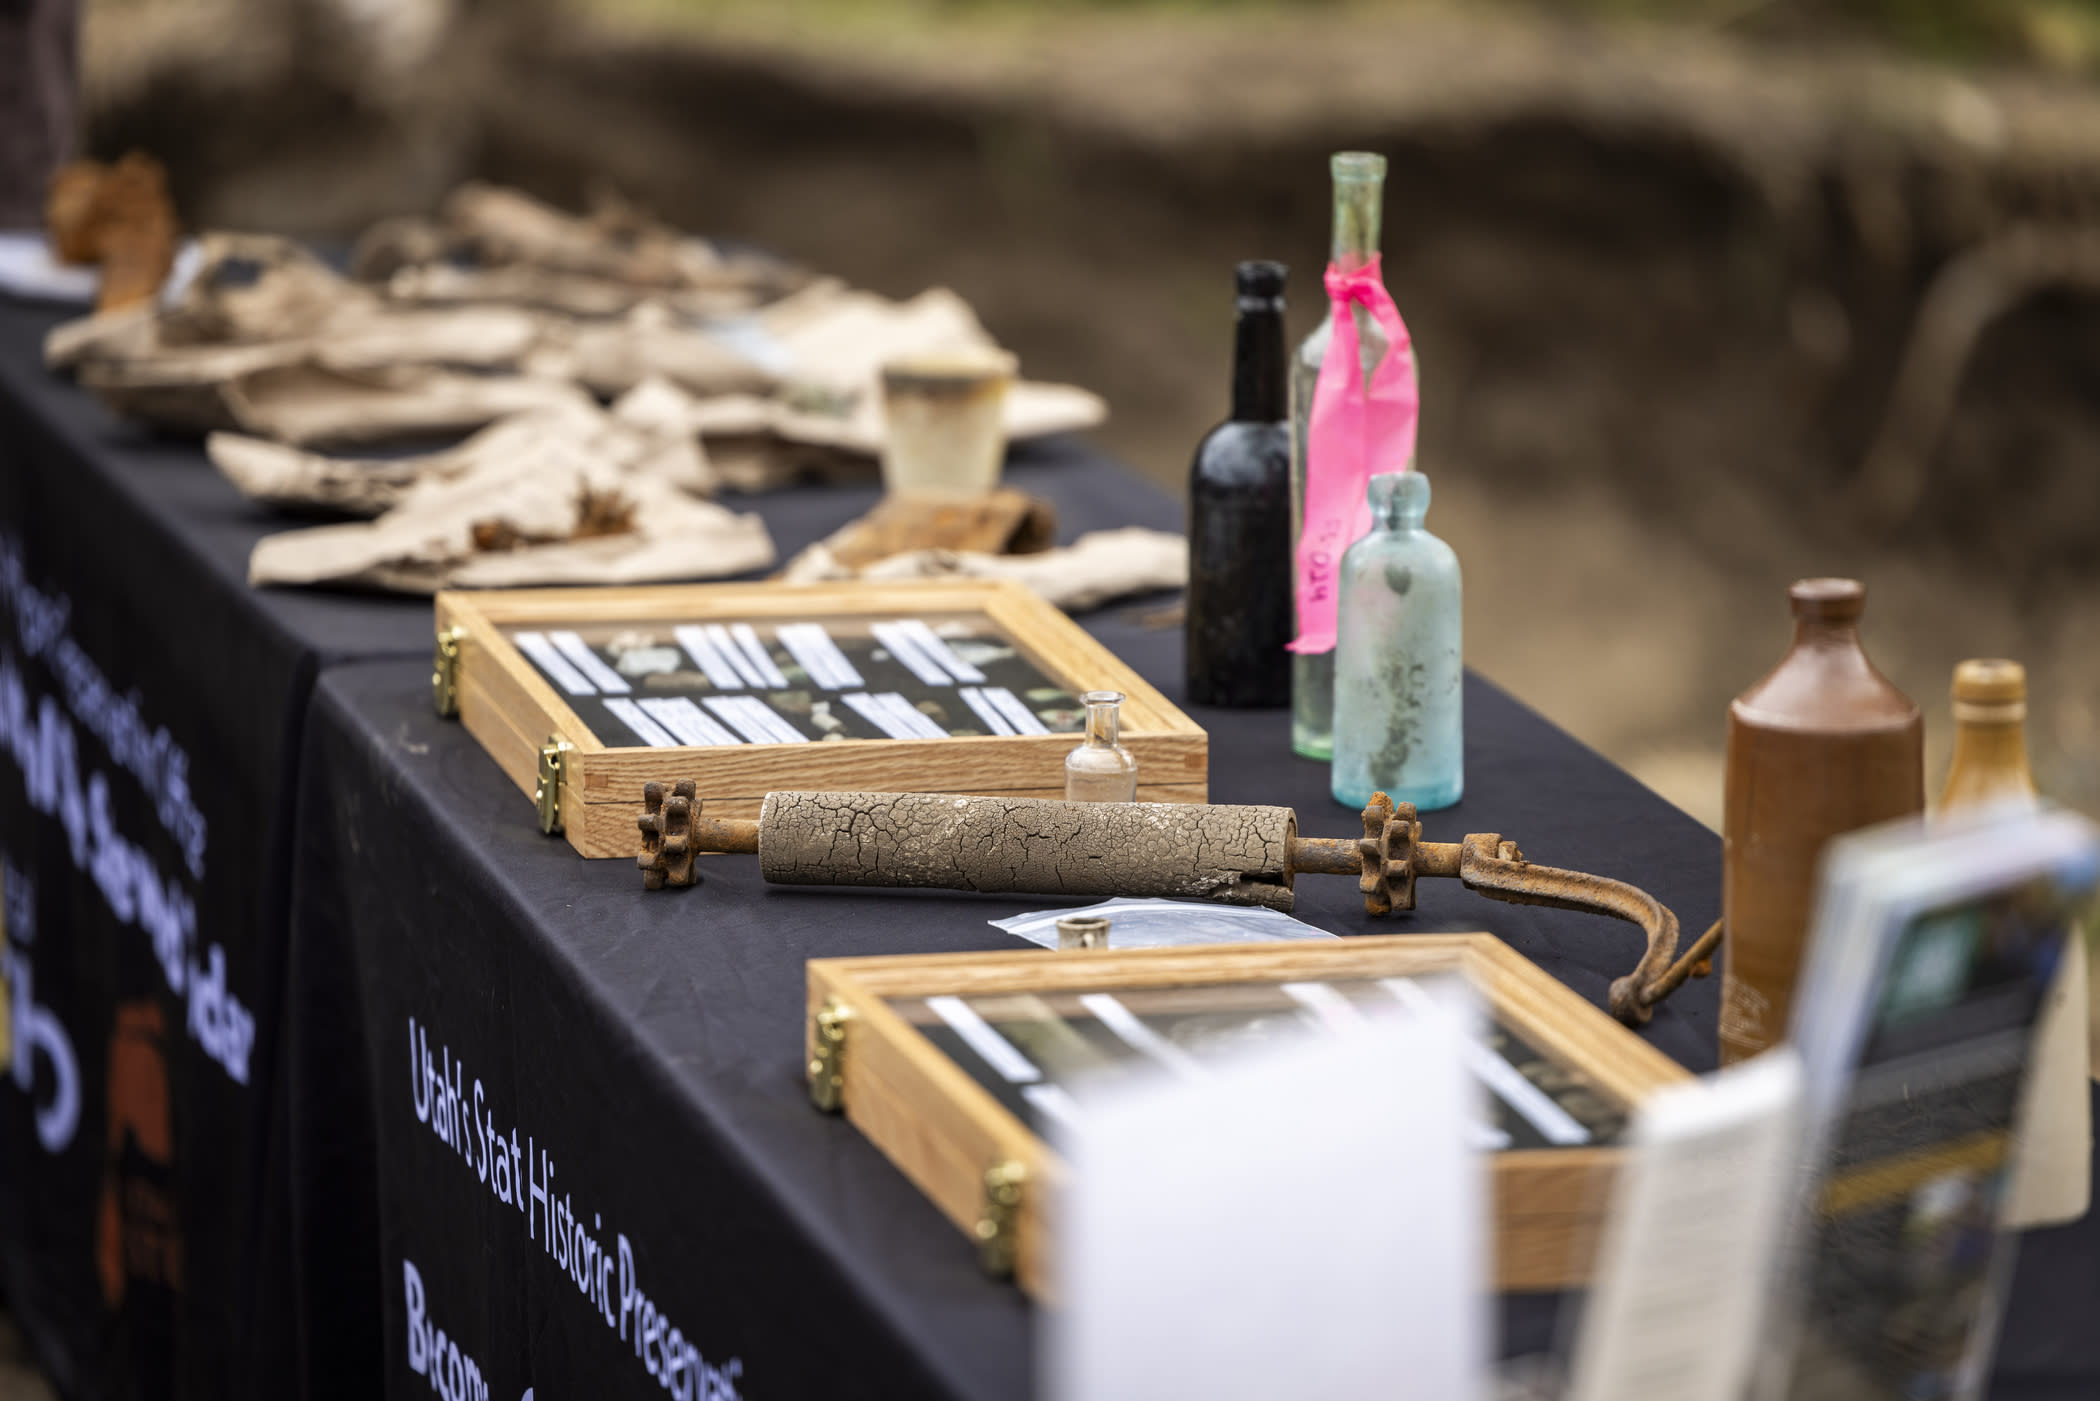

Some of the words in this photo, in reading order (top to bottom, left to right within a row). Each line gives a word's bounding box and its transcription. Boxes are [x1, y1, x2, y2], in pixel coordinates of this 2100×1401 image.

[409, 1017, 472, 1168] Utah's
[474, 1079, 524, 1212] Stat
[529, 1136, 616, 1328] Historic
